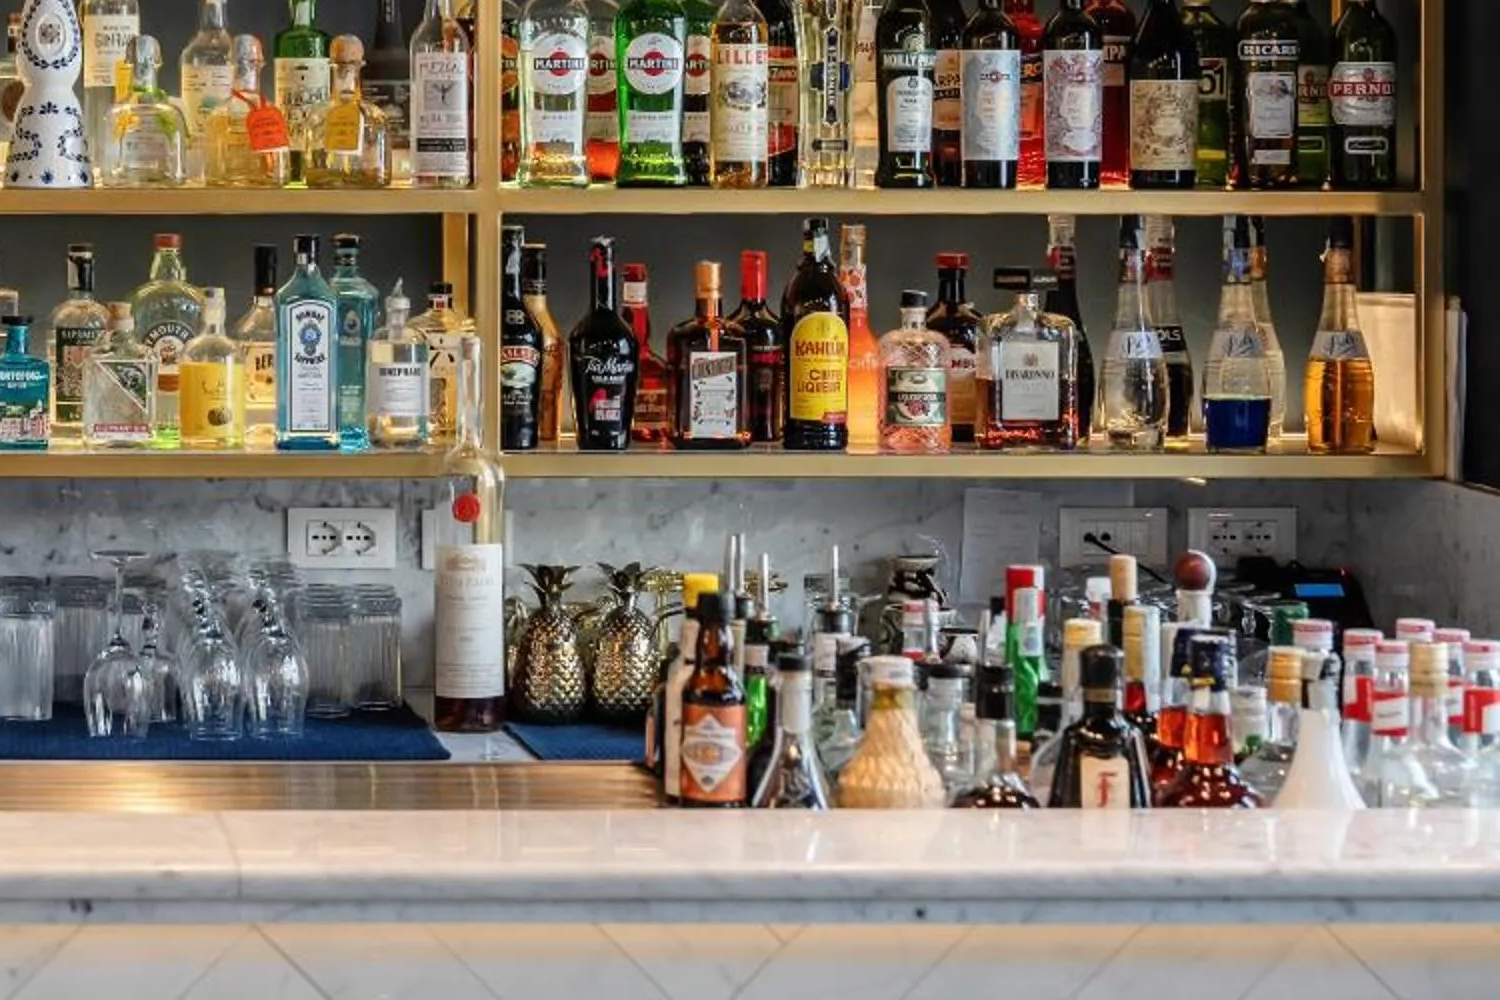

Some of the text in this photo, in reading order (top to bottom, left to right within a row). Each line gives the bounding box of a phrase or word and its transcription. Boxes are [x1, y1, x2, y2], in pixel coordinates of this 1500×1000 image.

[534, 58, 582, 71] MARTINI
[628, 58, 678, 71] MARTINI
[1198, 67, 1226, 97] 51
[1332, 82, 1394, 97] PERNO
[1158, 330, 1181, 342] OLS
[501, 346, 540, 366] AILEYS
